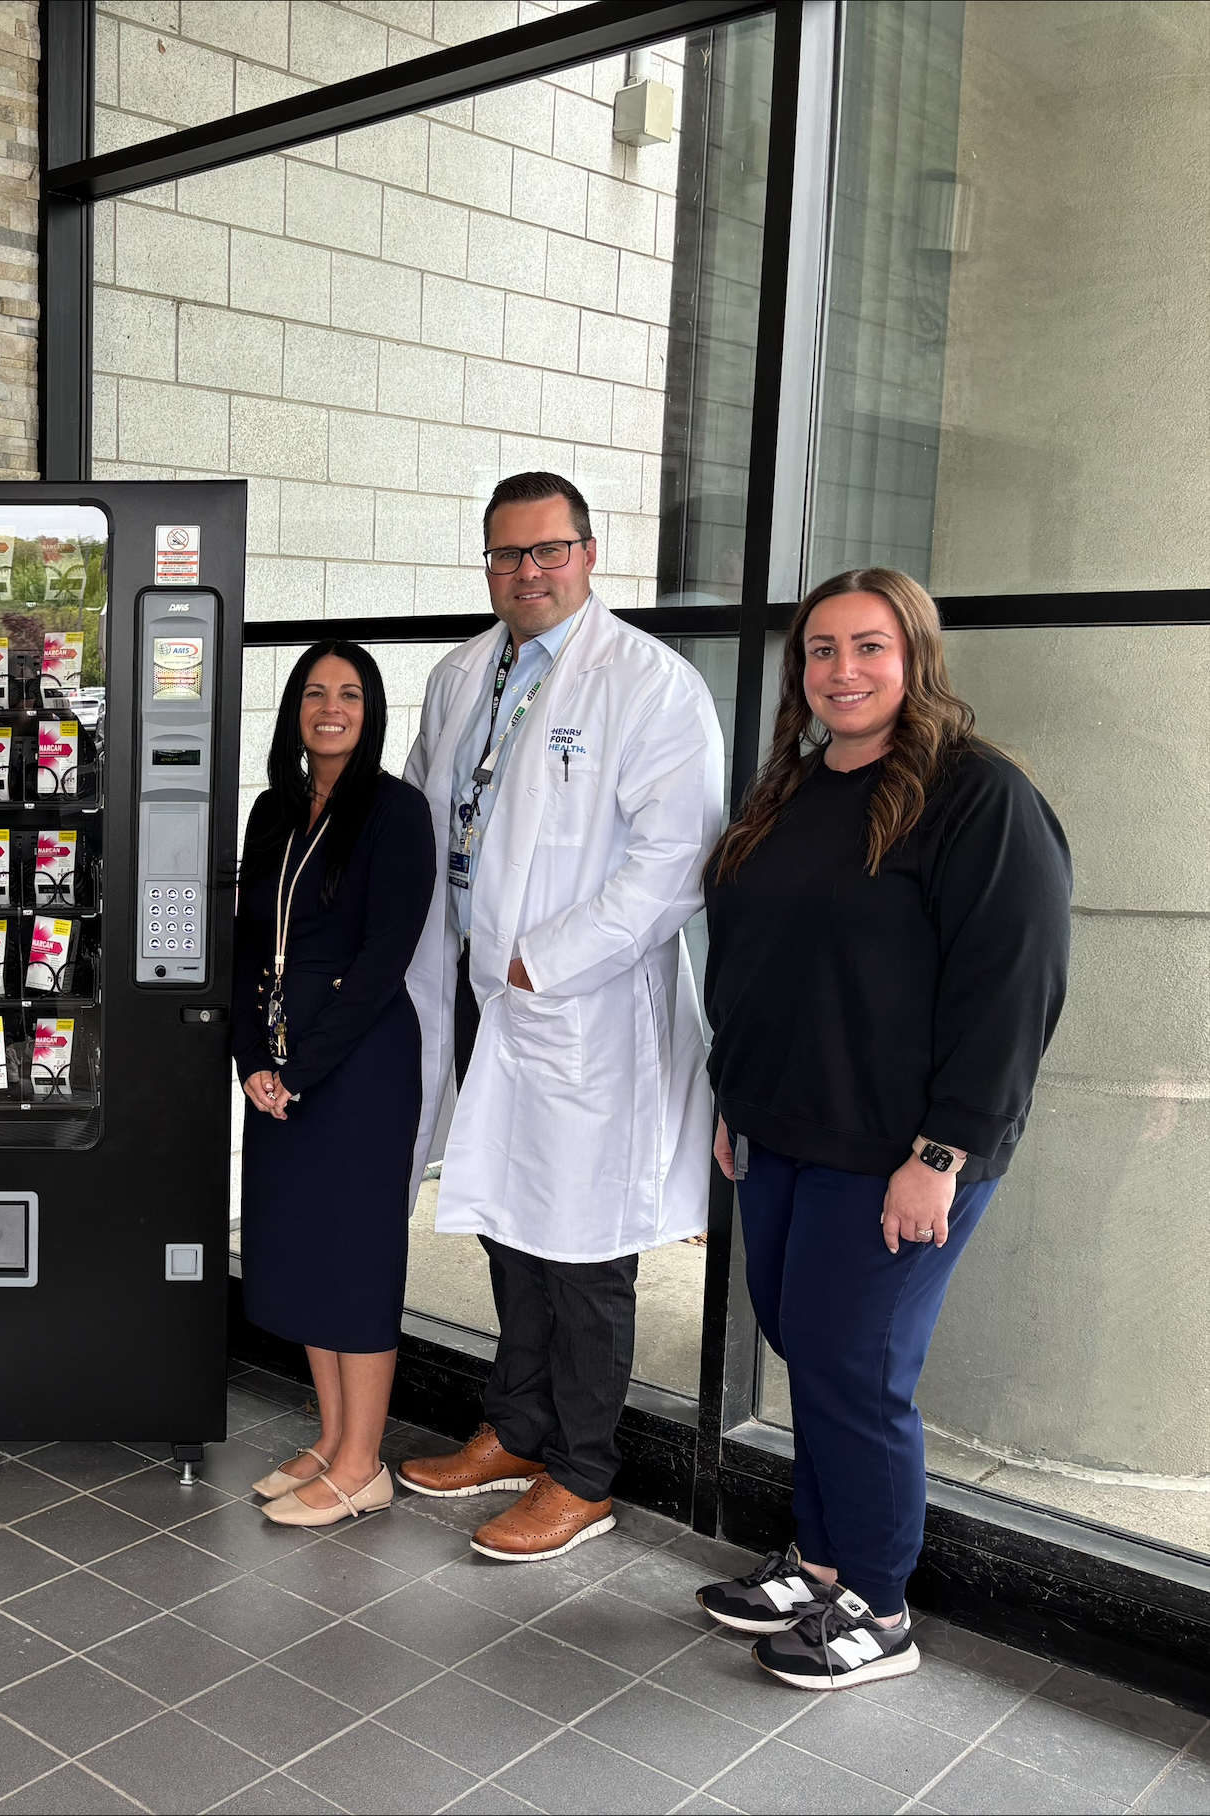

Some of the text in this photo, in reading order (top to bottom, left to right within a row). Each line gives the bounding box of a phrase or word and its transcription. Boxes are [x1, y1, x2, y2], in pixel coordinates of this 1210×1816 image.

[168, 604, 190, 612] AMS
[550, 728, 582, 736] HENRY
[550, 736, 574, 744] FORD
[32, 939, 54, 949] NARCAN
[827, 1628, 884, 1669] N
